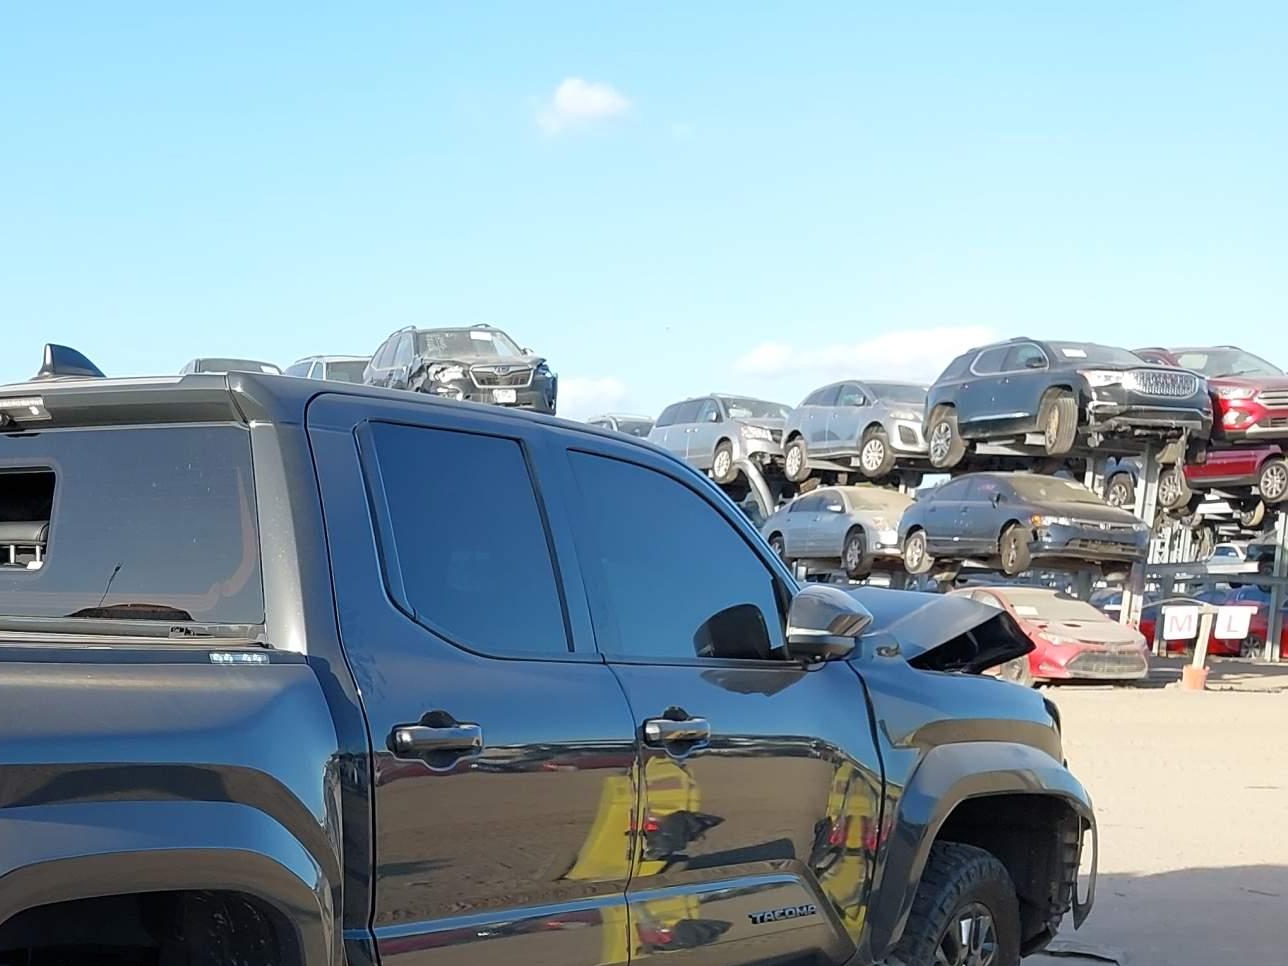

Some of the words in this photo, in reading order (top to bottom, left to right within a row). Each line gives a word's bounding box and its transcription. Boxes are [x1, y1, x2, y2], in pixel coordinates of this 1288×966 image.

[1170, 615, 1192, 632] M
[1227, 615, 1239, 632] L
[748, 904, 817, 924] TACOMA
